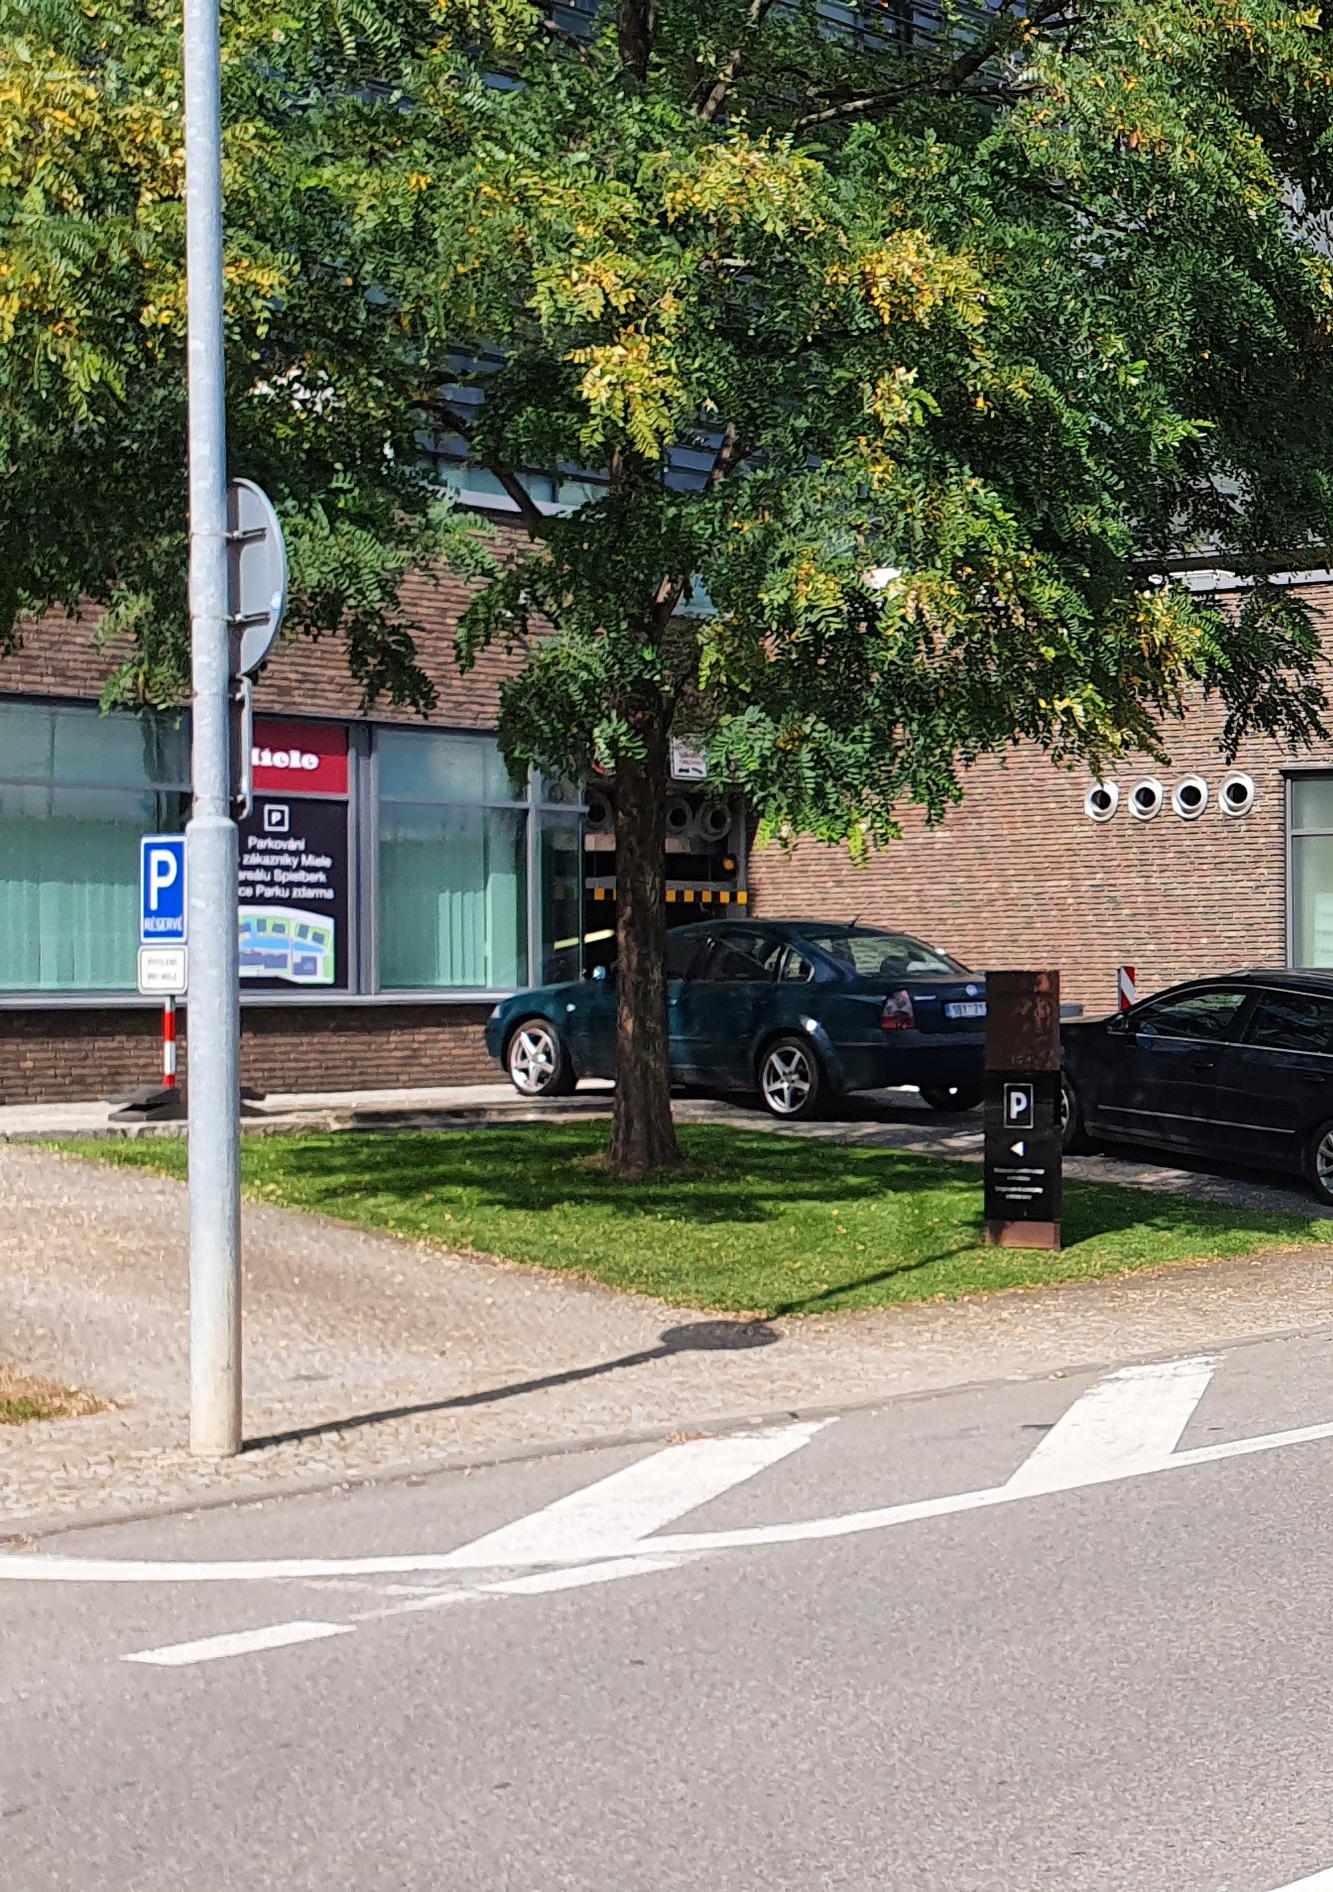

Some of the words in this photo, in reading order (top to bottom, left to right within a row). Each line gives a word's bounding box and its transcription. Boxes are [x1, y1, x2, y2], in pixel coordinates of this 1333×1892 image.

[271, 811, 282, 824] P
[248, 836, 305, 851] Parkování
[150, 849, 177, 911] P
[1010, 1092, 1027, 1119] P
